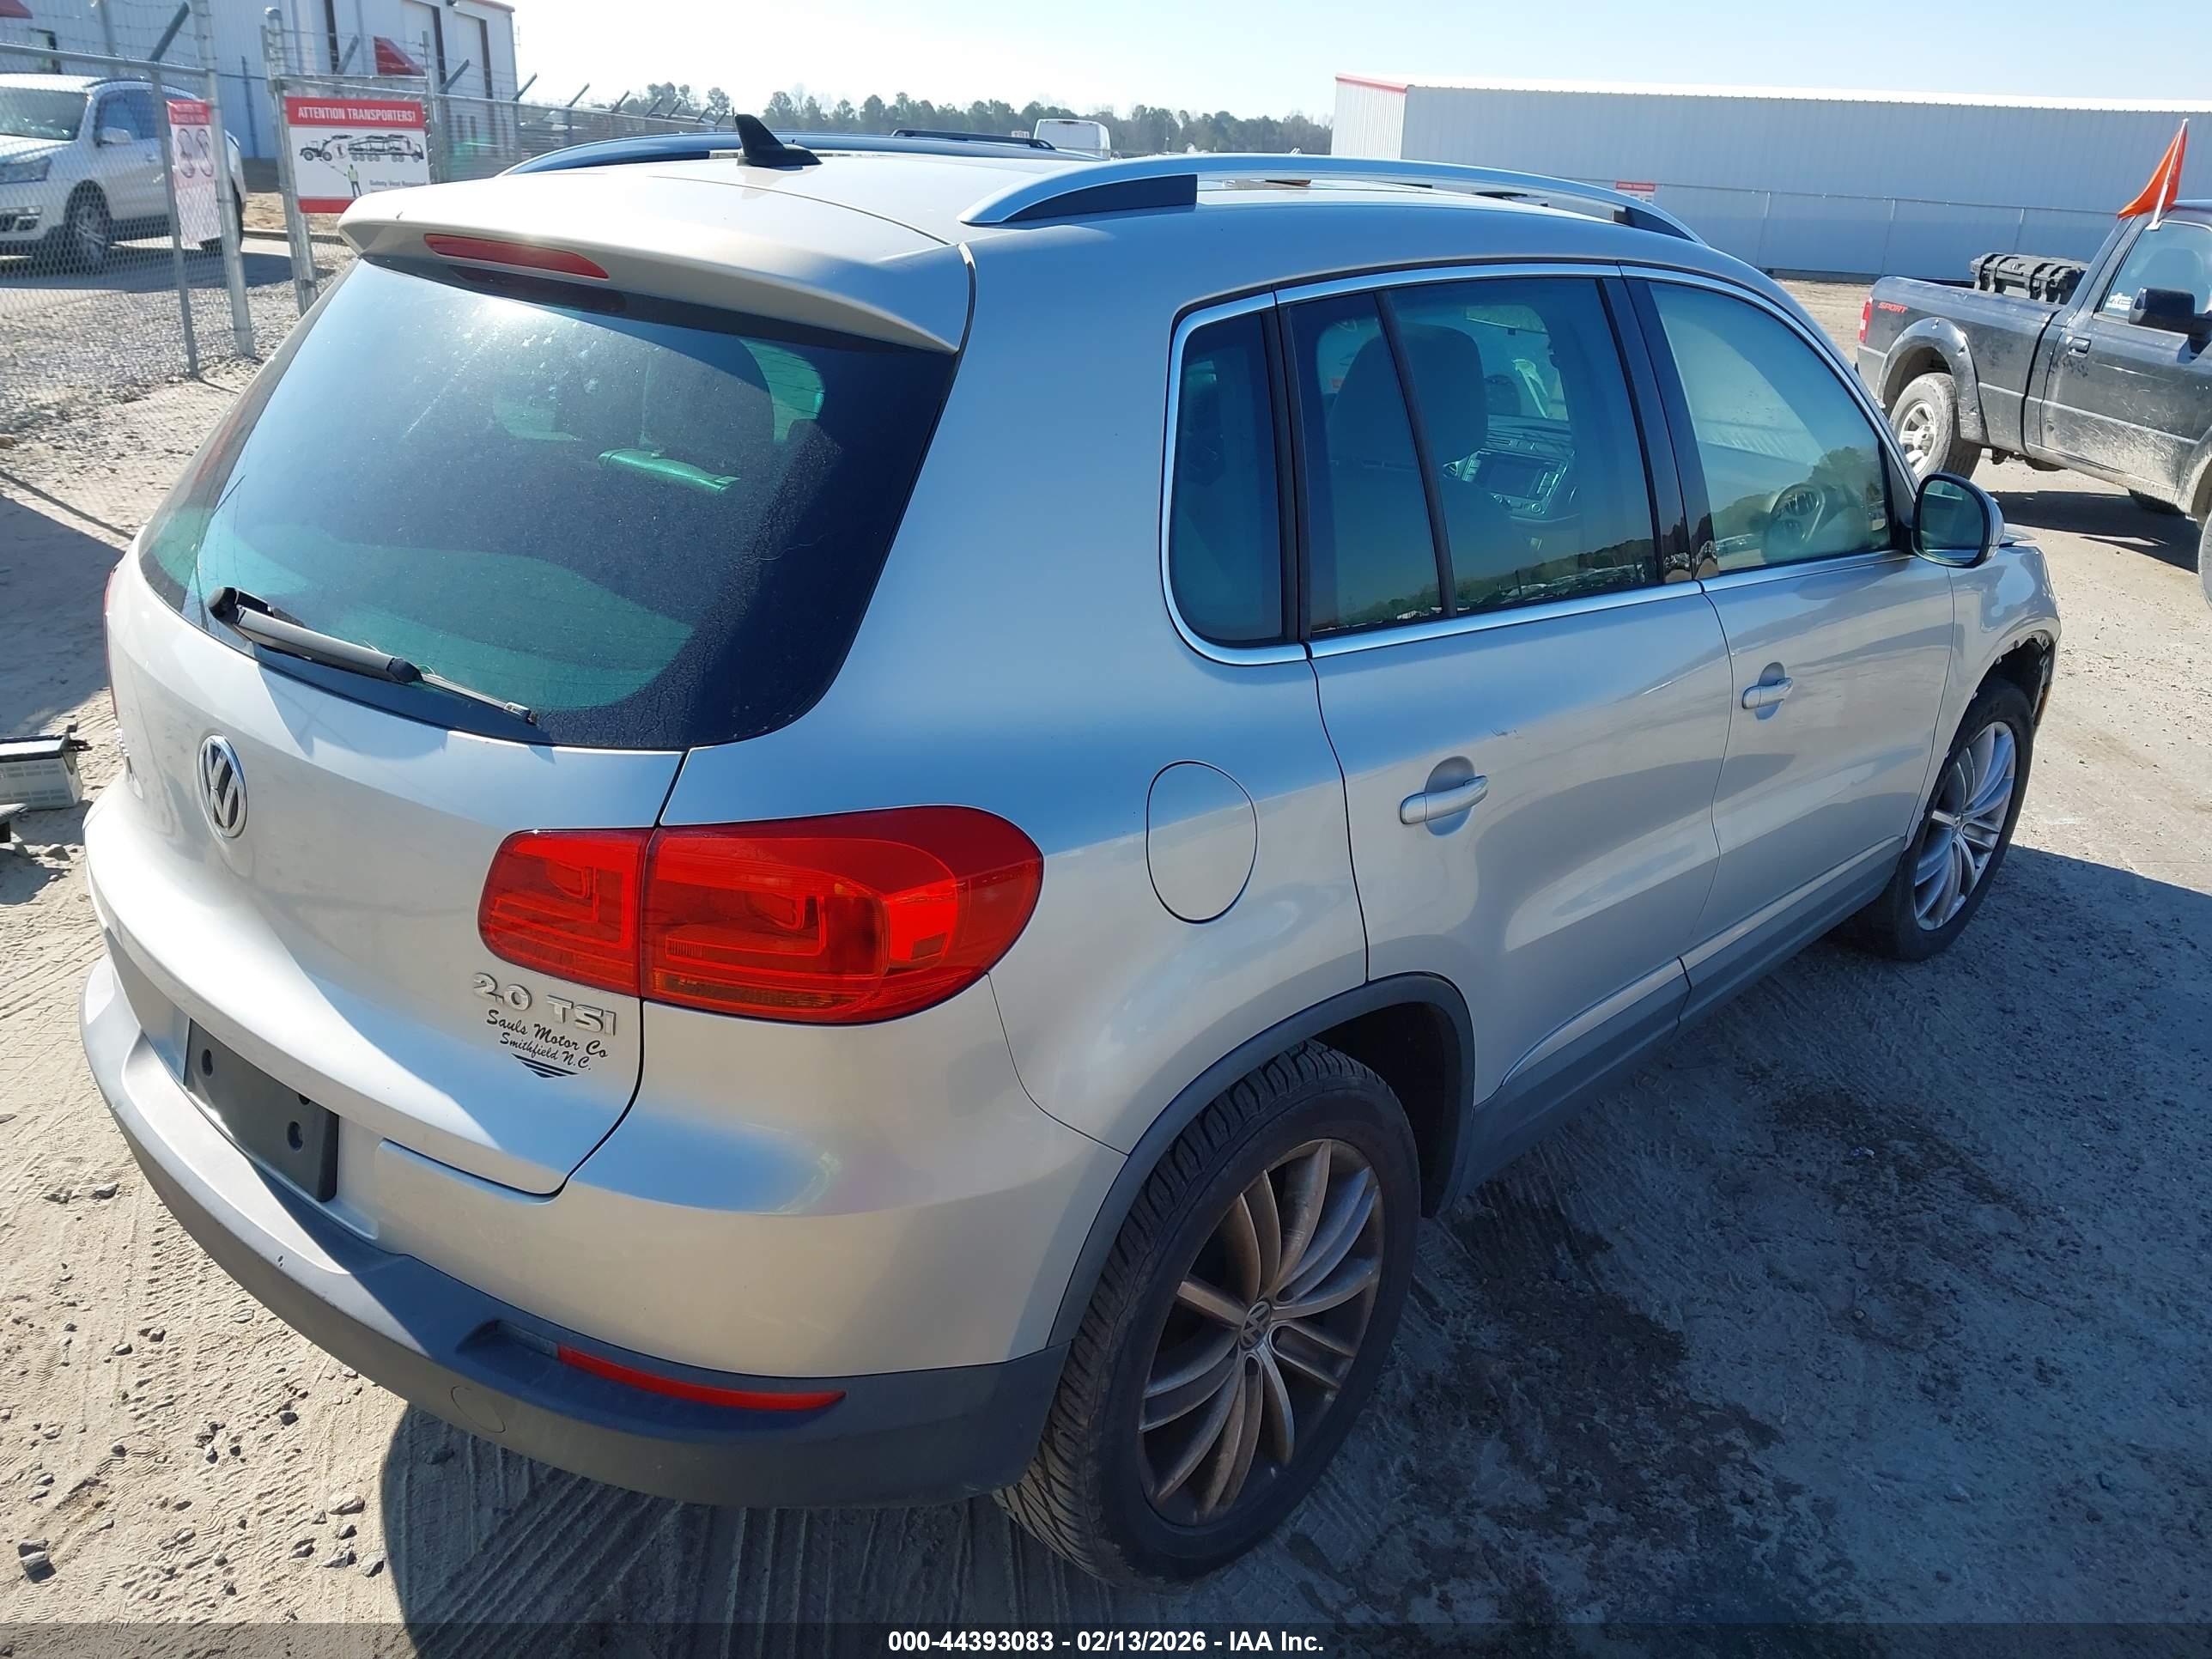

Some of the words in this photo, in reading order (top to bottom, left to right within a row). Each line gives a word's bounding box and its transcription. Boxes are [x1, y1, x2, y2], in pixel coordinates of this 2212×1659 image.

[298, 106, 345, 120] ATTENTION
[347, 108, 416, 122] TRANSPORTERS!
[1877, 301, 1909, 313] SPORT
[473, 971, 532, 1012] 2.0
[545, 994, 617, 1037] TSI
[486, 1009, 528, 1036] Sauls
[533, 1023, 580, 1051] Motor
[586, 1040, 608, 1059] Co
[500, 1032, 559, 1060] Smithfield
[562, 1050, 592, 1071] N.C.
